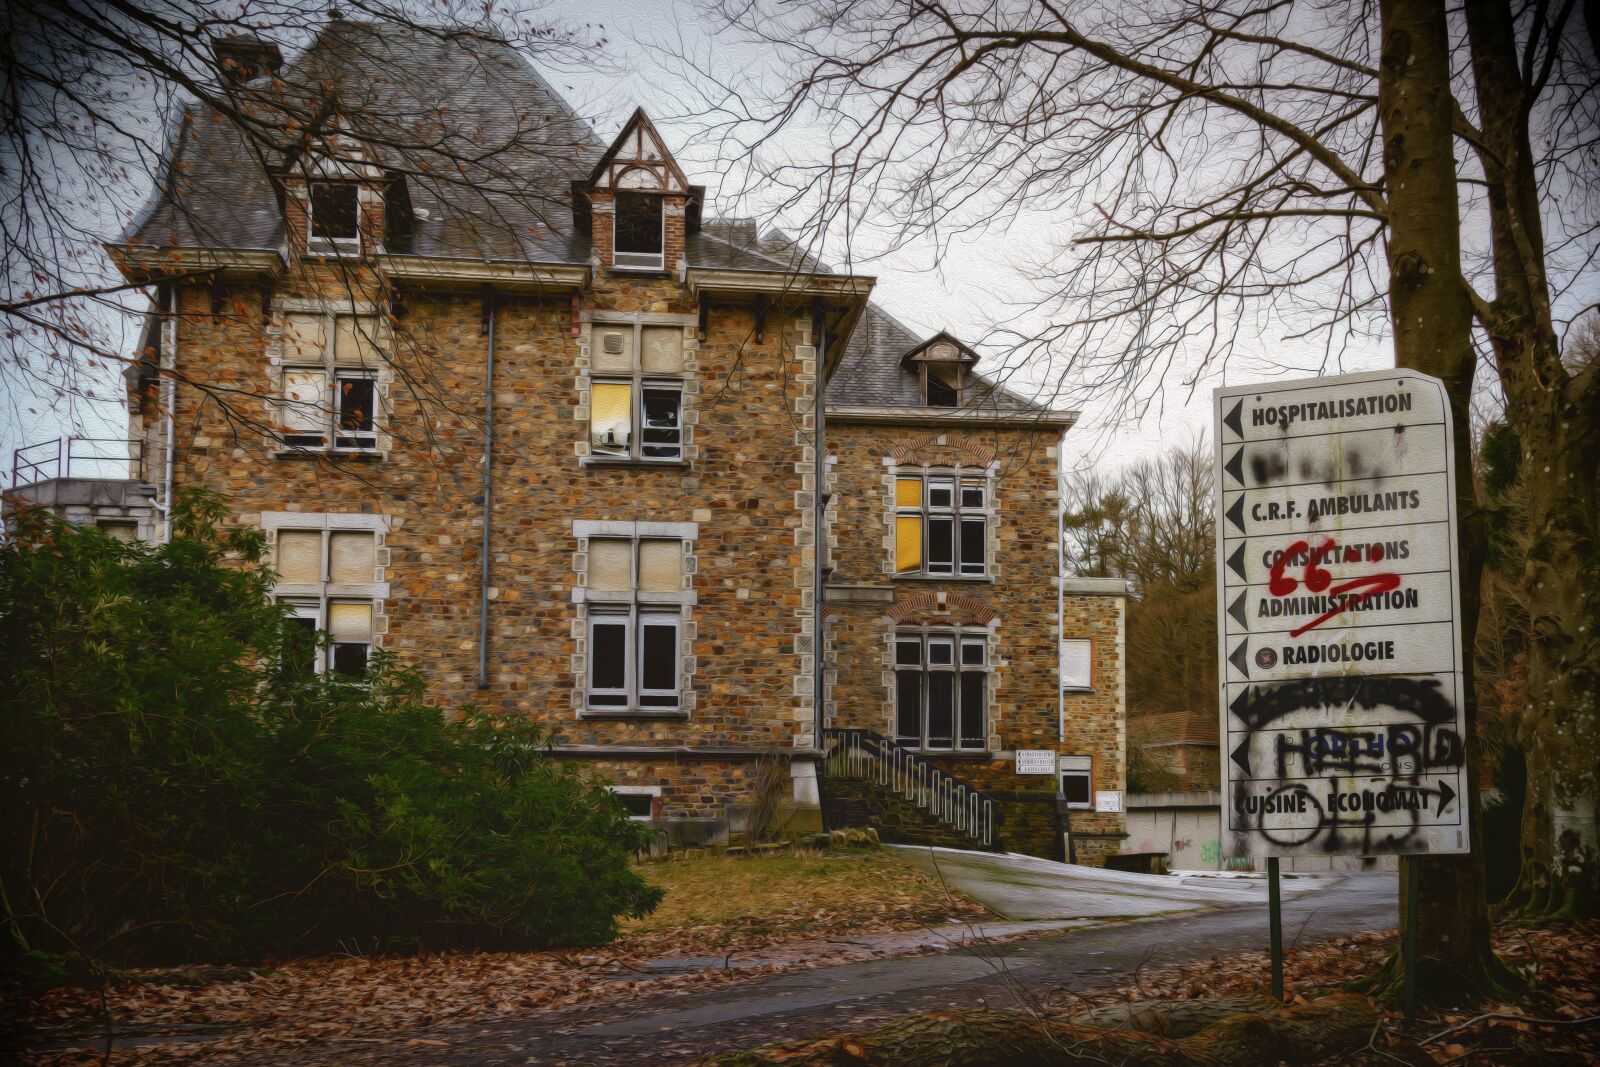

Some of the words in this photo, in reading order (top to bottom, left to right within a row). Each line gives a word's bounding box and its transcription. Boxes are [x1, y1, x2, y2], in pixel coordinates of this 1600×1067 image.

[1252, 393, 1412, 426] HOSPITALISATION
[1252, 501, 1301, 522] C.R.F.
[1307, 490, 1420, 518] AMBULANTS
[1262, 540, 1410, 568] CONSULTATIONS
[1258, 588, 1418, 617] ADMINISTRATION
[1283, 641, 1395, 665] RADIOLOGIE
[1327, 792, 1429, 811] ECONOMAT
